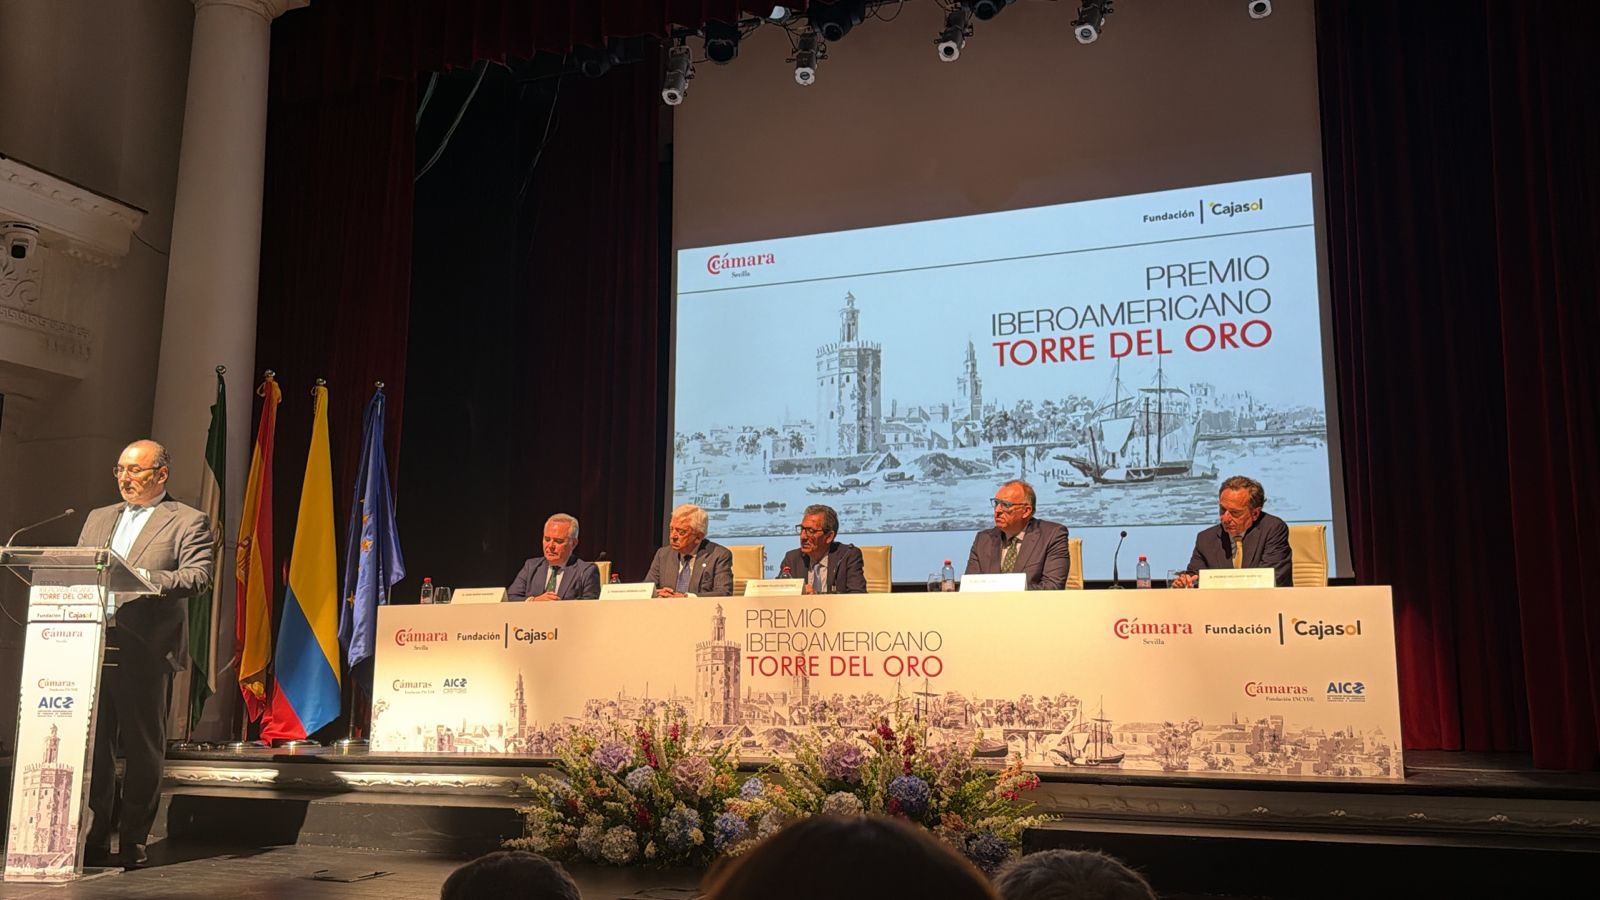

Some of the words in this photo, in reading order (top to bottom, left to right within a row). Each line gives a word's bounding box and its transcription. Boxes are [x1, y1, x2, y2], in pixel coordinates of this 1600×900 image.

[1143, 209, 1195, 222] Fundación
[1209, 198, 1263, 217] Cajasol
[731, 270, 750, 278] Sevilla
[1145, 255, 1270, 290] PREMIO
[992, 288, 1271, 336] IBEROAMERICANO
[992, 334, 1095, 367] TORRE
[1109, 328, 1173, 358] DEL
[1185, 320, 1272, 352] ORO
[68, 611, 92, 620] Cajasol
[746, 608, 826, 629] PREMIO
[456, 632, 500, 641] Fundación
[513, 627, 558, 644] Cajasol
[1205, 623, 1271, 635] Fundación
[1291, 617, 1362, 640] Cajasol
[746, 631, 943, 652] IBEROAMERICANO
[746, 656, 820, 677] TORRE
[830, 656, 873, 677] DEL
[883, 655, 943, 678] ORO
[1245, 681, 1308, 697] Cámaras
